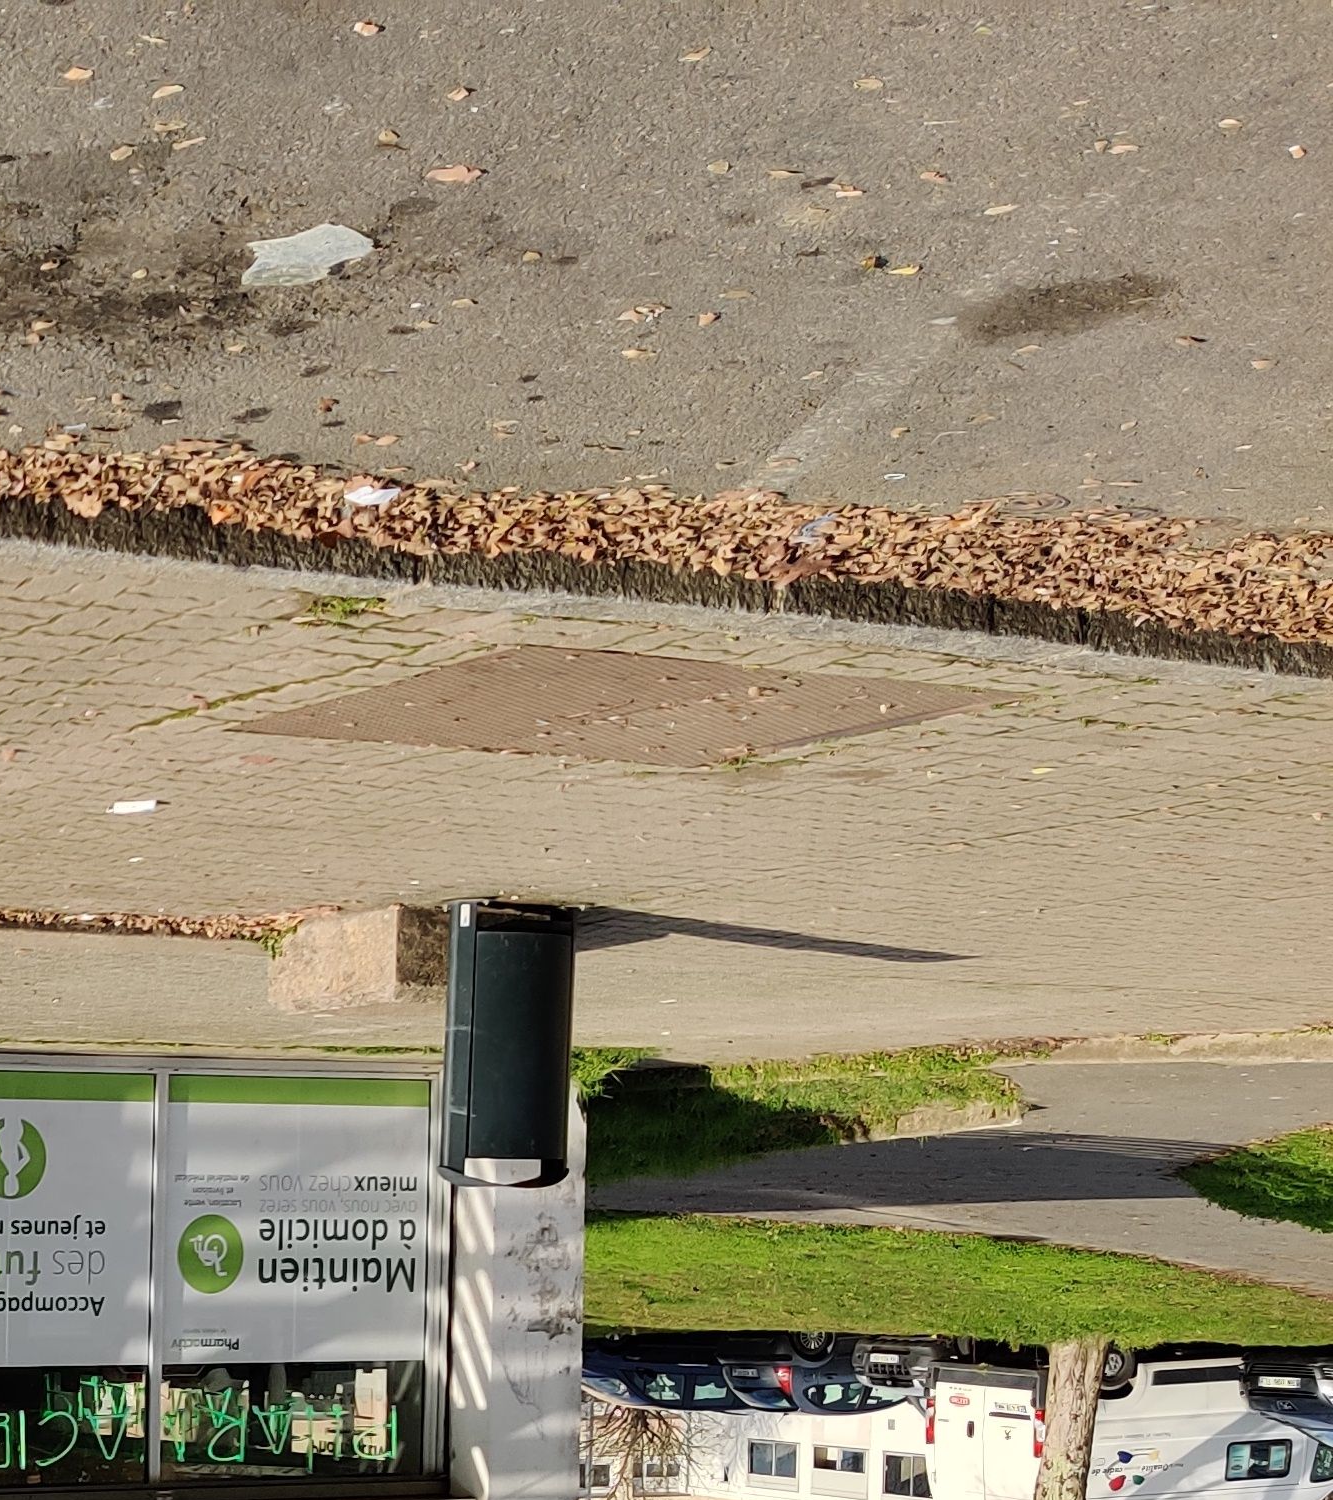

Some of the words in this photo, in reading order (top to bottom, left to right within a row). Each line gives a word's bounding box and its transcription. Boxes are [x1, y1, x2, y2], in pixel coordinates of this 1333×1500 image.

[259, 1175, 303, 1193] vous
[309, 1175, 351, 1197] chez
[354, 1175, 417, 1197] mieux
[259, 1200, 297, 1214] serez
[302, 1200, 334, 1213] vous
[340, 1198, 380, 1213] nous,
[385, 1199, 417, 1213] avec
[11, 1215, 81, 1240] jeunes
[85, 1220, 106, 1238] et
[259, 1219, 388, 1250] domicile
[399, 1219, 416, 1250] à
[52, 1250, 105, 1285] des
[258, 1258, 416, 1293] Maintien
[171, 1338, 240, 1351] Pharmactiv
